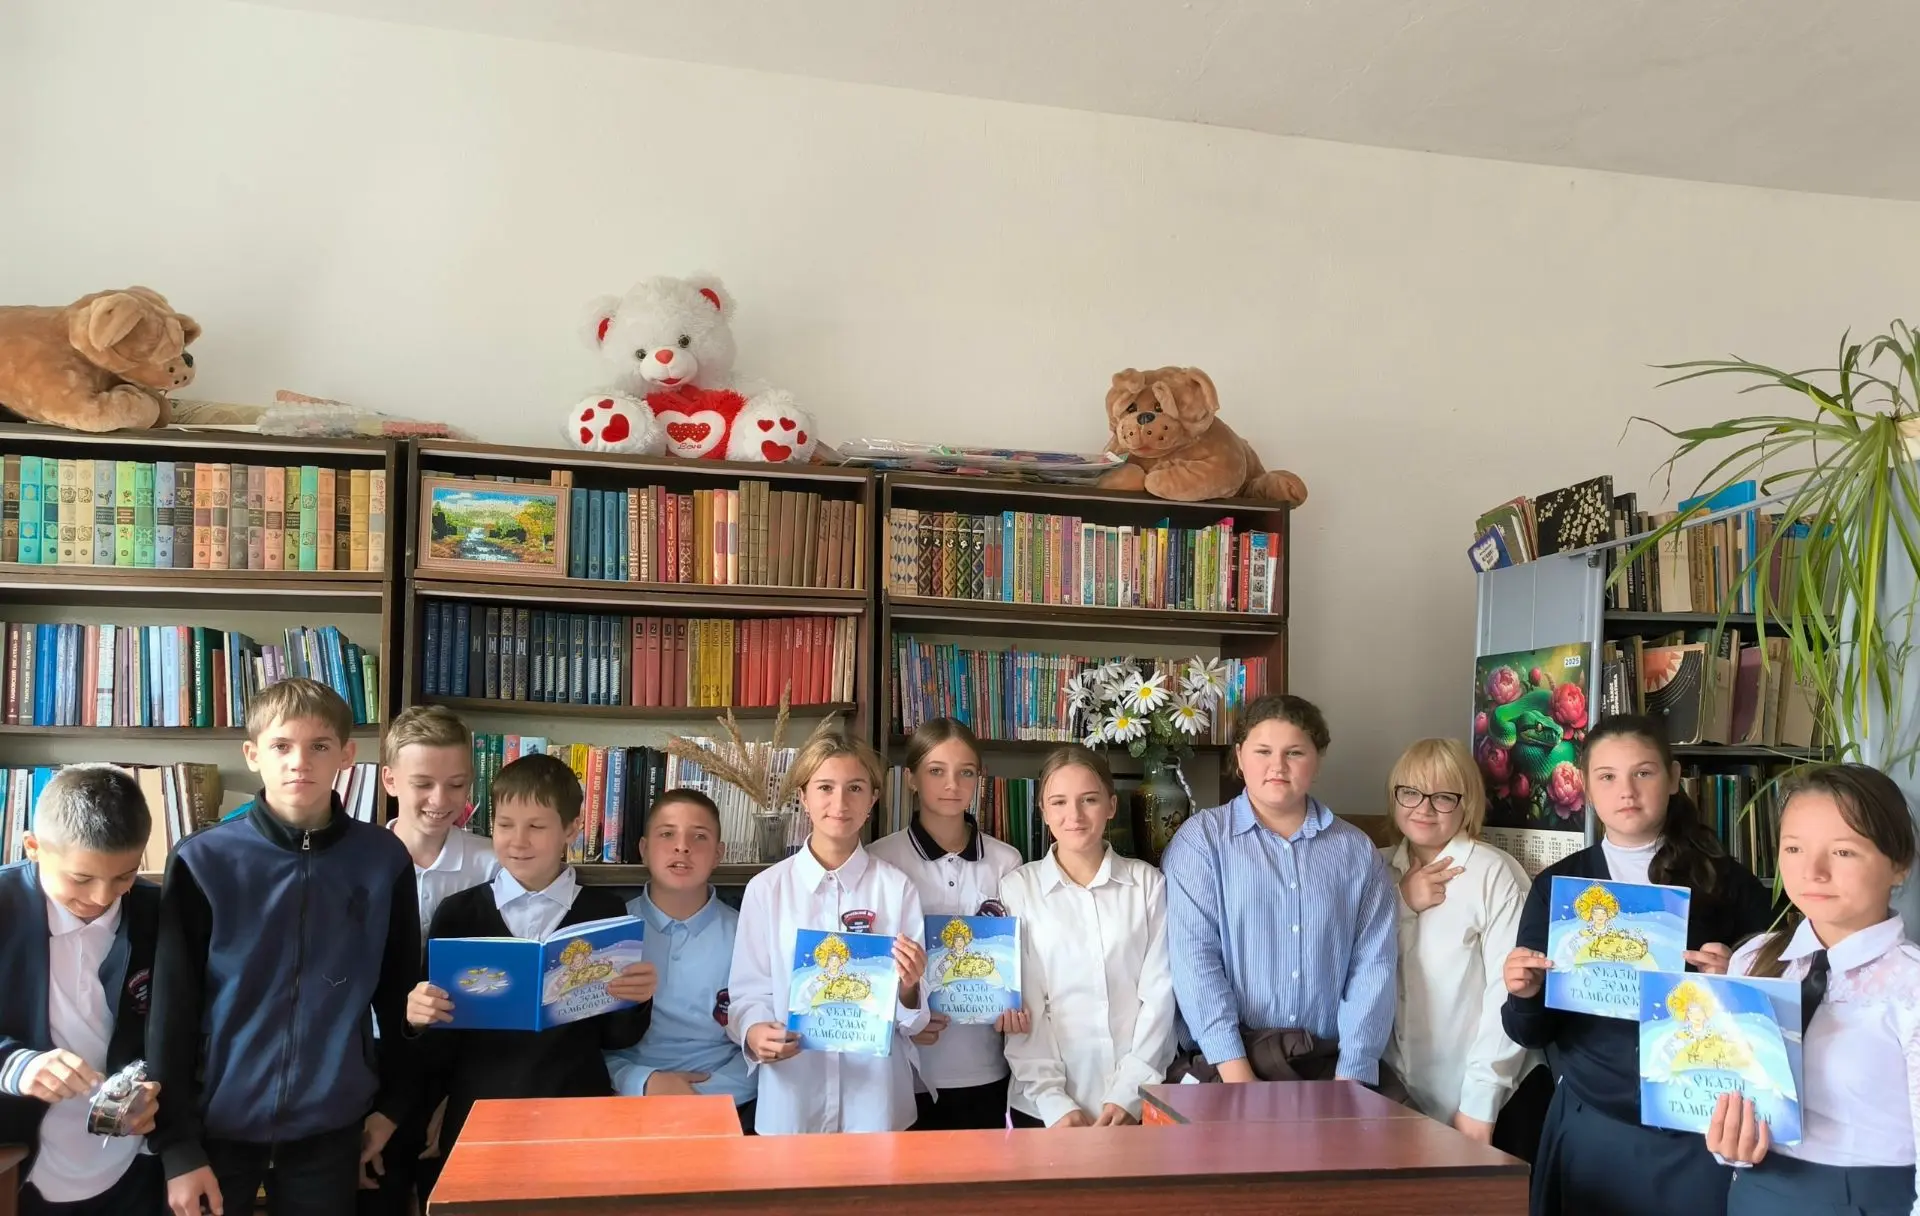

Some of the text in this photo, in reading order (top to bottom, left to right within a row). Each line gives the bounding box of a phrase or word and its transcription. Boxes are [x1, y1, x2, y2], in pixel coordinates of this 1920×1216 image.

[947, 539, 954, 548] 3
[1565, 658, 1580, 667] 2025
[613, 751, 622, 775] ДЕТЕЙ
[613, 777, 621, 792] ДЛЯ
[587, 749, 603, 856] ЭНЦИКЛОПЕДИЯ ДЛЯ ДЕТЕЙ
[1592, 966, 1637, 981] СКАЗЫ
[573, 983, 606, 998] СКАЗЫ
[956, 983, 988, 993] СКАЗЫ
[1583, 977, 1640, 993] О ЗЕМЛ
[949, 993, 994, 1003] О ЗЕМЛЕ
[1570, 988, 1639, 1007] ТАМБОВСК
[826, 1007, 862, 1018] СКАЗЫ
[818, 1017, 867, 1030] О ЗЕМЛЕ
[1693, 1073, 1745, 1091] СКАЗЫ
[1683, 1087, 1693, 1099] О
